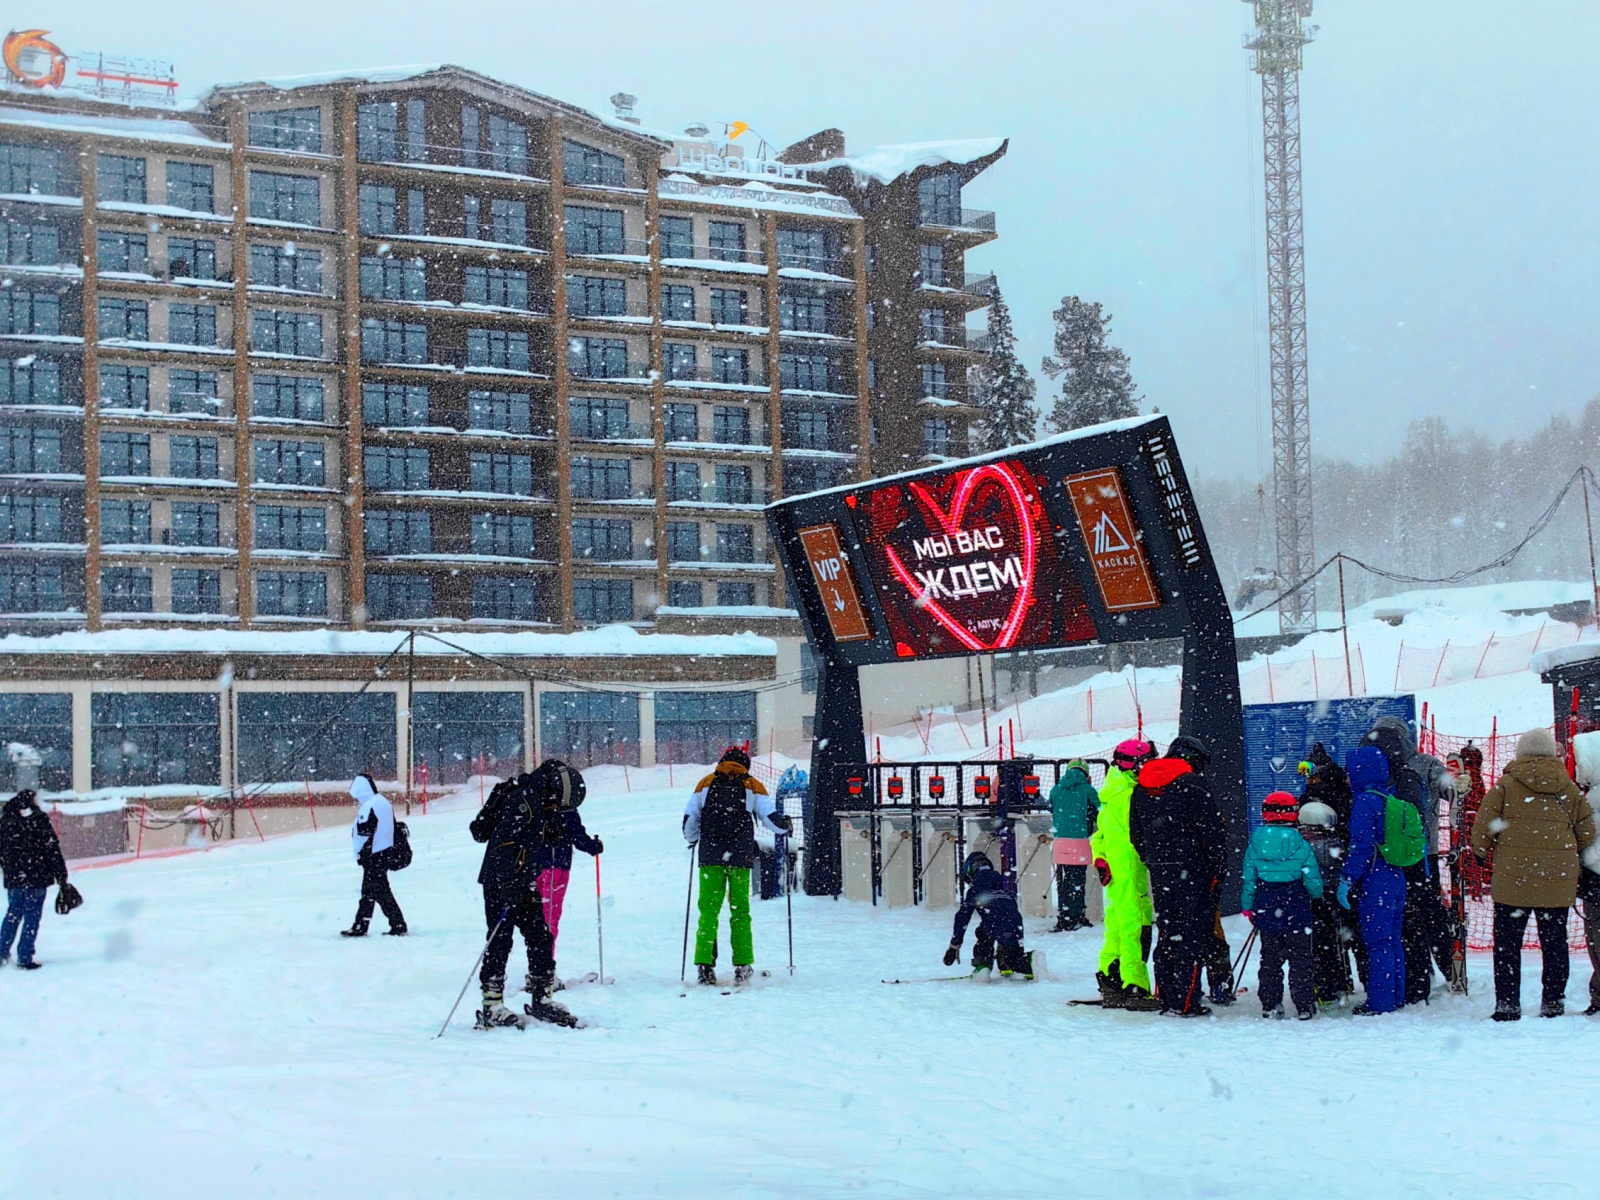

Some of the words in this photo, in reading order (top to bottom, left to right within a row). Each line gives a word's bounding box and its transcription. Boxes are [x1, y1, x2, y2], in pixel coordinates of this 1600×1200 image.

[913, 534, 953, 560] МЫ
[955, 526, 1004, 554] ВАС
[814, 557, 841, 582] VIP
[914, 557, 1027, 601] ЖДЕМ!
